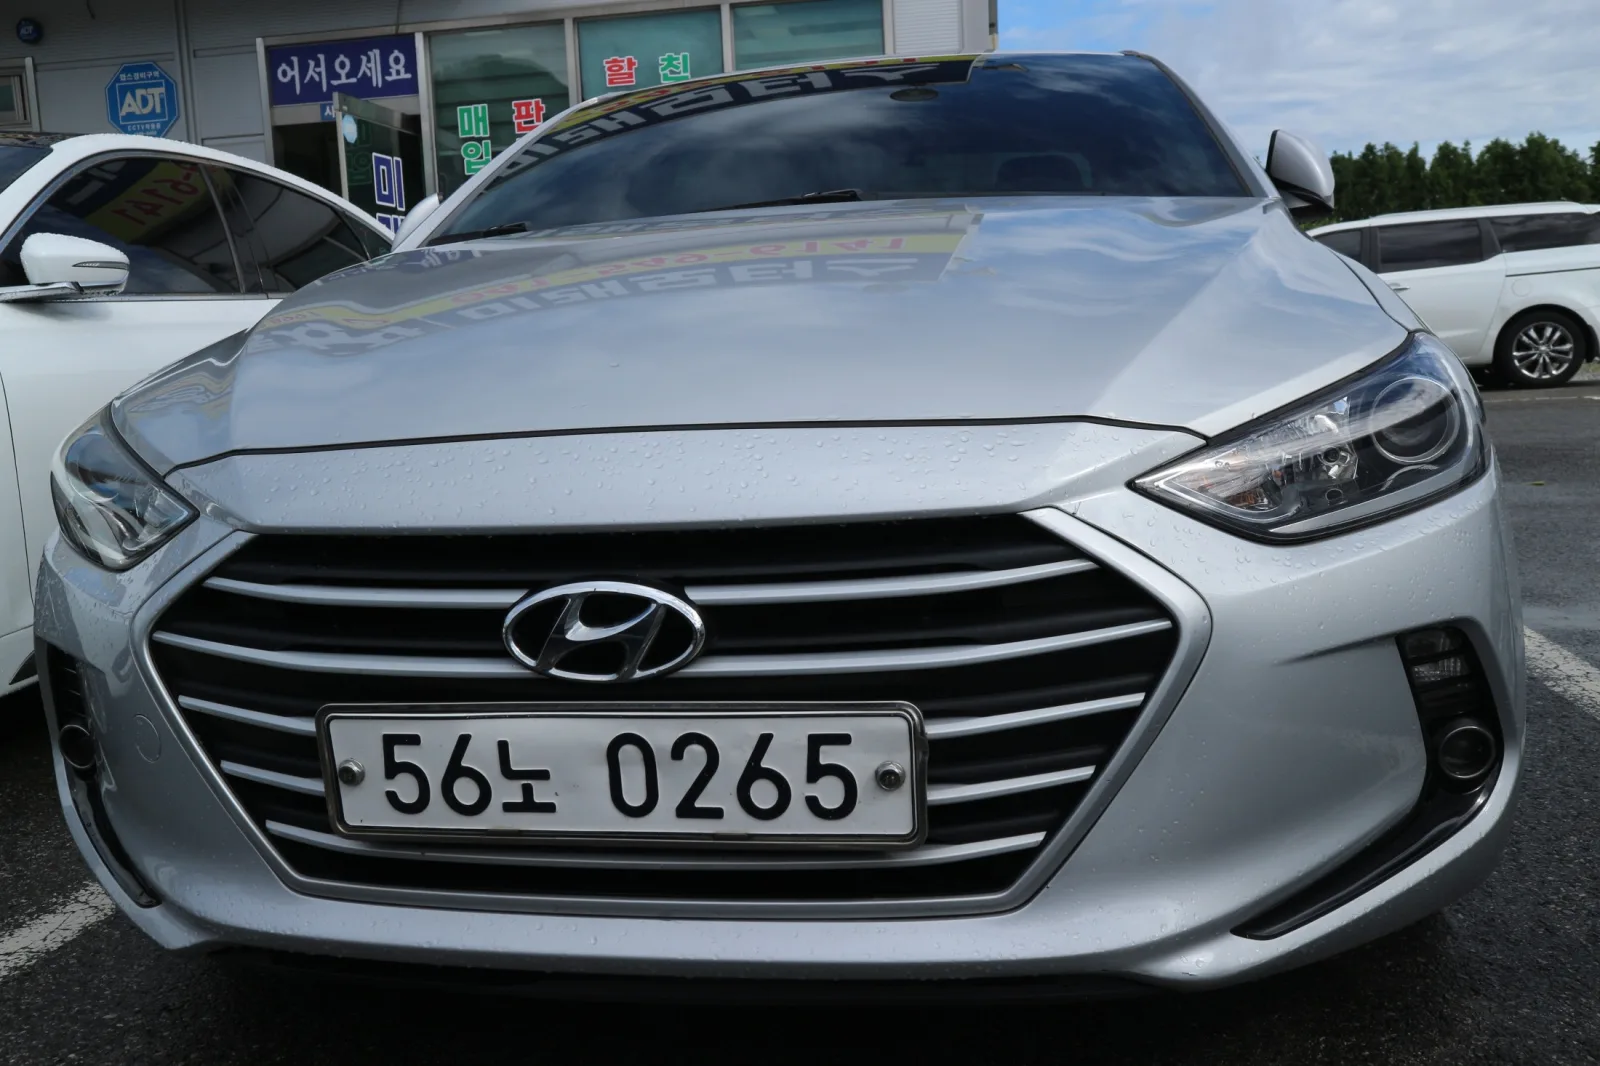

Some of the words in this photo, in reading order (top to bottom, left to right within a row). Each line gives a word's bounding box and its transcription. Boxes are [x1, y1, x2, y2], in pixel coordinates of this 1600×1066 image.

[277, 49, 412, 96] 어서오세요
[603, 56, 637, 87] 할
[658, 52, 691, 83] 친
[119, 87, 166, 117] ADT
[382, 733, 557, 817] 56노
[606, 732, 858, 821] 0265
